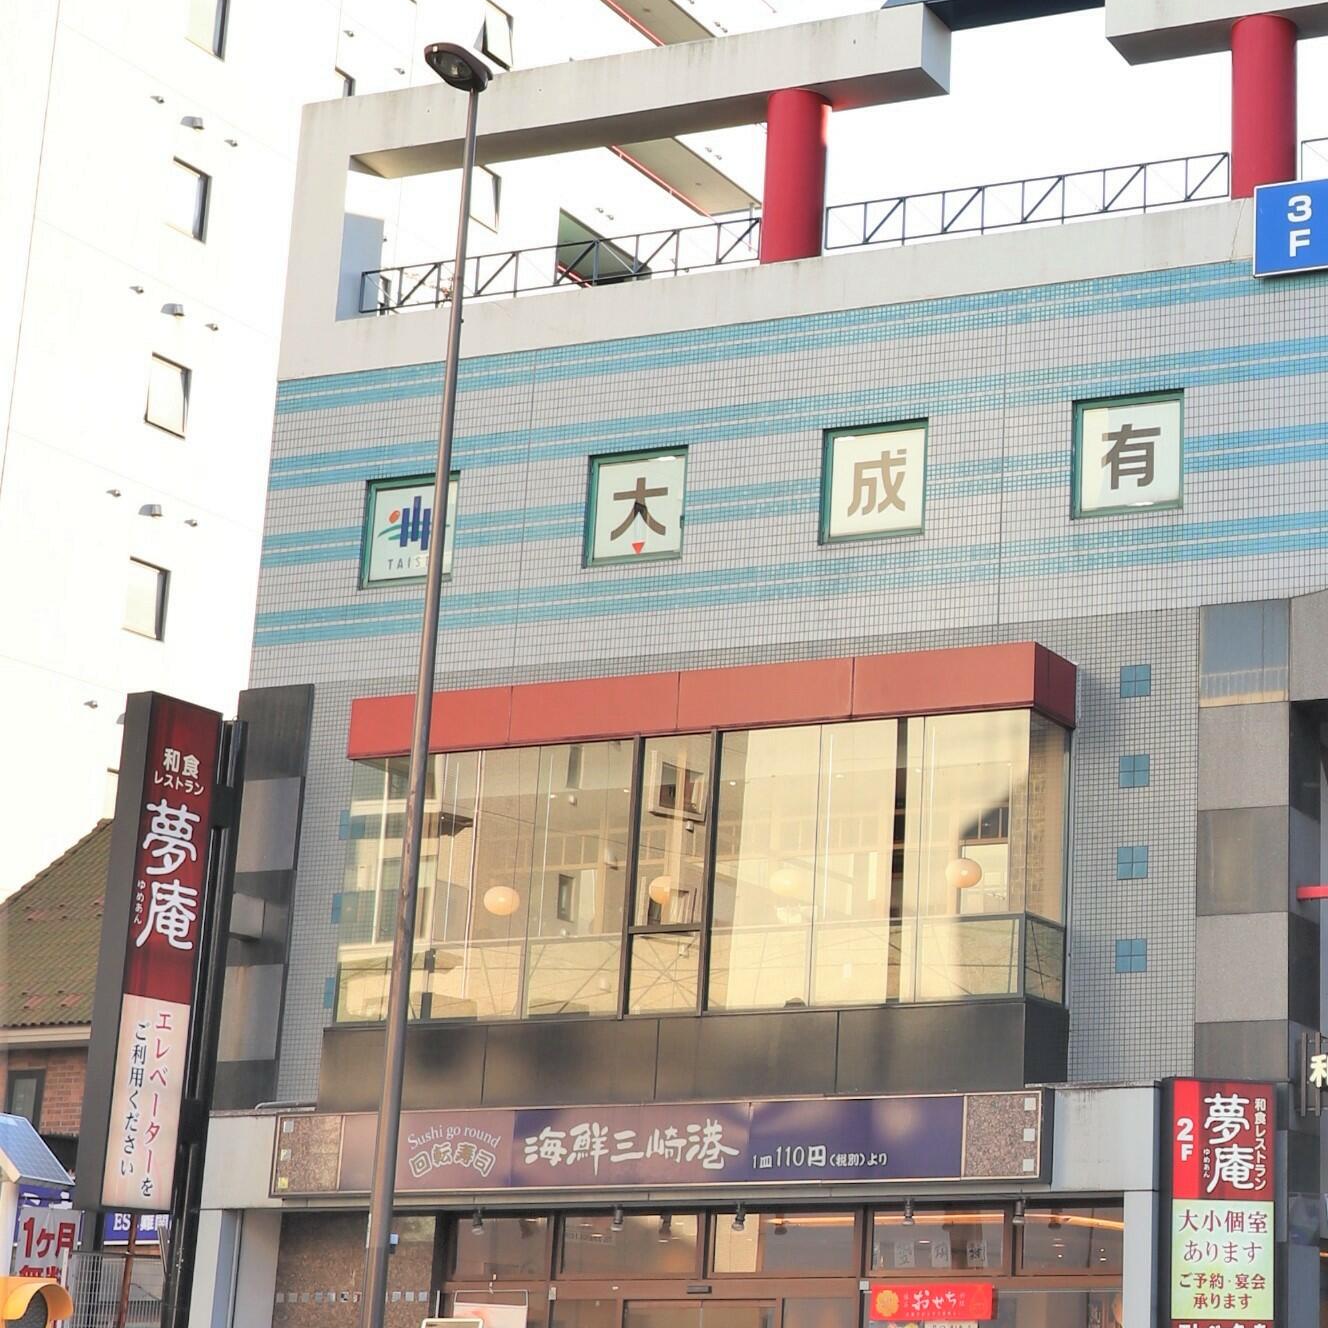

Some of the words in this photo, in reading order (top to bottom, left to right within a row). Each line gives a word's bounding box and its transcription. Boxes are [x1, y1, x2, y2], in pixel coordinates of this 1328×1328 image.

[611, 478, 668, 541] 大
[847, 450, 909, 518] 成
[1101, 423, 1164, 491] 有
[388, 556, 430, 570] TAIS
[162, 747, 200, 778] 和食
[153, 770, 205, 796] レストラン
[135, 798, 201, 951] 夢庵
[133, 879, 146, 925] ゆめあん
[118, 1023, 148, 1178] ご利用ください
[140, 1011, 174, 1198] エレベーターを
[407, 1125, 443, 1150] Sushi
[446, 1124, 462, 1141] go
[463, 1126, 502, 1149] round
[524, 1118, 741, 1176] 海鮮三崎港
[1203, 1092, 1255, 1193] 夢庵
[1254, 1097, 1267, 1191] 和食レストラン
[409, 1141, 497, 1178] 回転寿司
[1202, 1148, 1211, 1179] ゆめあん
[1178, 1208, 1268, 1234] 大小個室
[1183, 1239, 1263, 1264] あります
[1179, 1272, 1266, 1290] ご予約・宴会
[911, 1289, 958, 1311] おせち
[1193, 1292, 1253, 1310] 承ります
